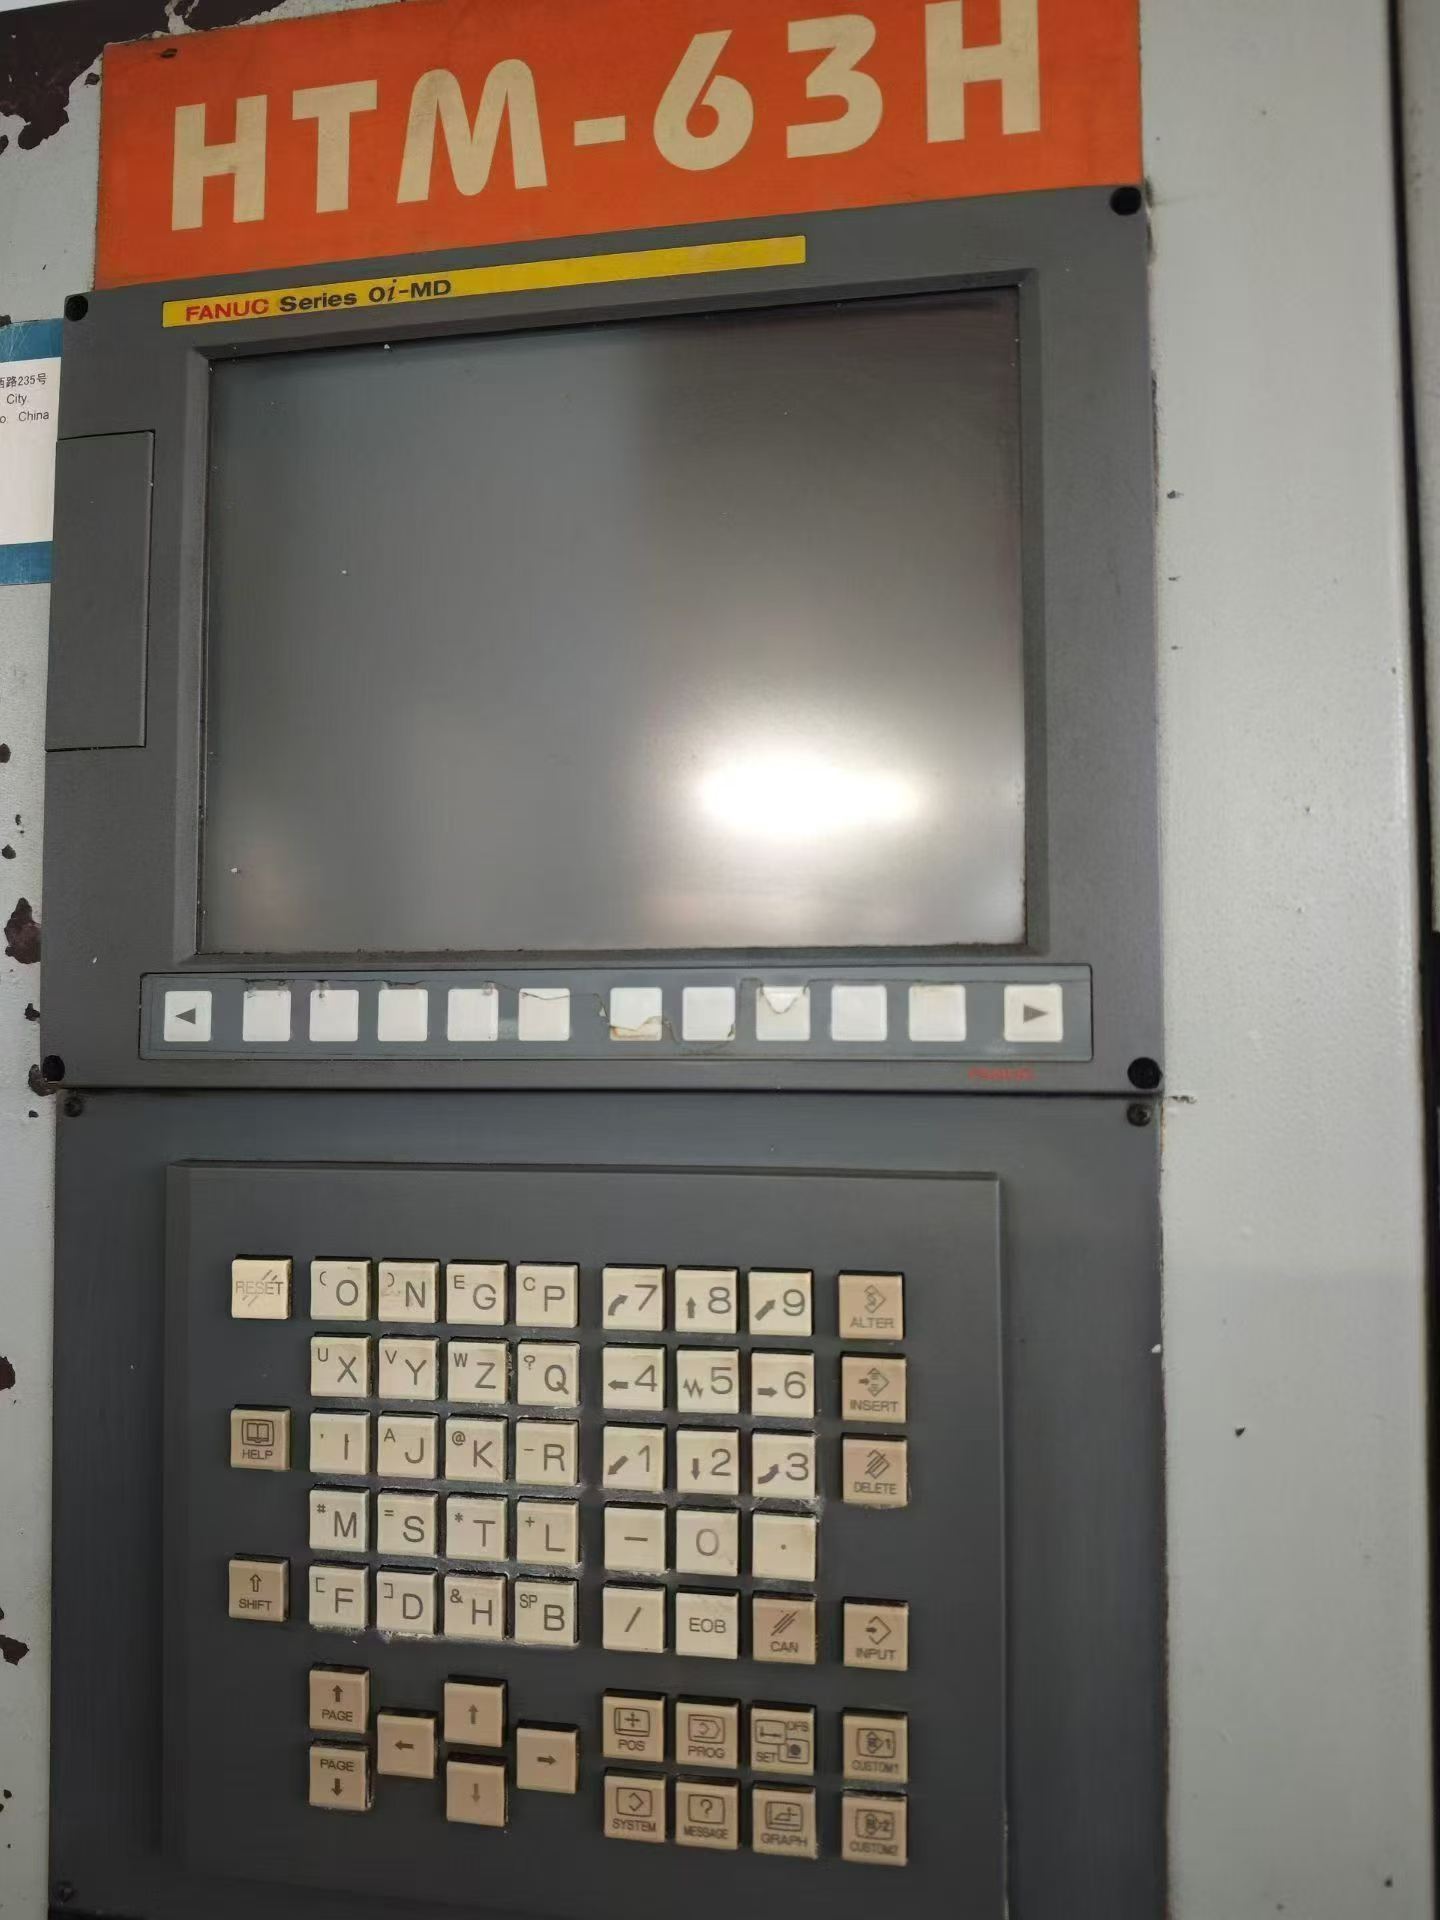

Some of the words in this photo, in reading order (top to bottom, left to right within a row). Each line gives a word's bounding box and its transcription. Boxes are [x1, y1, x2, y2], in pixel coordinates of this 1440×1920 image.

[172, 0, 1042, 231] HTM-63H
[186, 299, 269, 322] FANUC
[279, 290, 357, 313] Series
[18, 411, 49, 421] China
[235, 1280, 284, 1296] RESET
[405, 1281, 426, 1309] N
[454, 1275, 465, 1290] E
[473, 1284, 497, 1310] G
[523, 1277, 535, 1292] C
[544, 1285, 565, 1312] P
[633, 1284, 657, 1311] 7
[708, 1286, 732, 1314] 8
[782, 1289, 806, 1316] 9
[850, 1316, 895, 1330] ALTER
[317, 1348, 329, 1363] U
[337, 1356, 358, 1383] X
[385, 1351, 397, 1364] V
[405, 1359, 426, 1385] Y
[453, 1353, 468, 1368] W
[475, 1362, 496, 1390] Z
[523, 1355, 536, 1370] ?
[544, 1364, 569, 1395] Q
[634, 1364, 658, 1392] 4
[711, 1366, 733, 1395] 5
[784, 1371, 806, 1399] 6
[850, 1399, 899, 1413] INSERT
[241, 1449, 273, 1460] HELP
[343, 1434, 349, 1460] I
[383, 1428, 396, 1443] A
[404, 1438, 424, 1464] J
[473, 1440, 493, 1468] K
[543, 1443, 565, 1471] R
[638, 1445, 651, 1472] 1
[711, 1449, 732, 1477] 2
[786, 1453, 809, 1480] 3
[853, 1482, 897, 1495] DELETE
[316, 1503, 327, 1513] #
[334, 1512, 357, 1539] M
[403, 1516, 425, 1543] S
[473, 1520, 496, 1547] T
[525, 1517, 535, 1527] +
[545, 1524, 565, 1552] L
[238, 1599, 272, 1611] SHIFT
[335, 1588, 354, 1614] F
[402, 1594, 423, 1620] D
[449, 1588, 463, 1603] &
[472, 1599, 493, 1625] H
[520, 1594, 538, 1609] SP
[544, 1605, 565, 1631] B
[689, 1617, 726, 1634] EOB
[770, 1641, 798, 1653] CAN
[856, 1649, 896, 1660] INPUT
[321, 1710, 353, 1722] PAGE
[787, 1721, 808, 1732] OFS
[617, 1739, 645, 1751] POS
[688, 1746, 725, 1759] PROG
[755, 1751, 777, 1763] SET
[320, 1759, 354, 1772] PAGE
[612, 1819, 655, 1832] SYSTEM
[683, 1826, 728, 1839] MESSAGE
[761, 1833, 808, 1847] GRAPH
